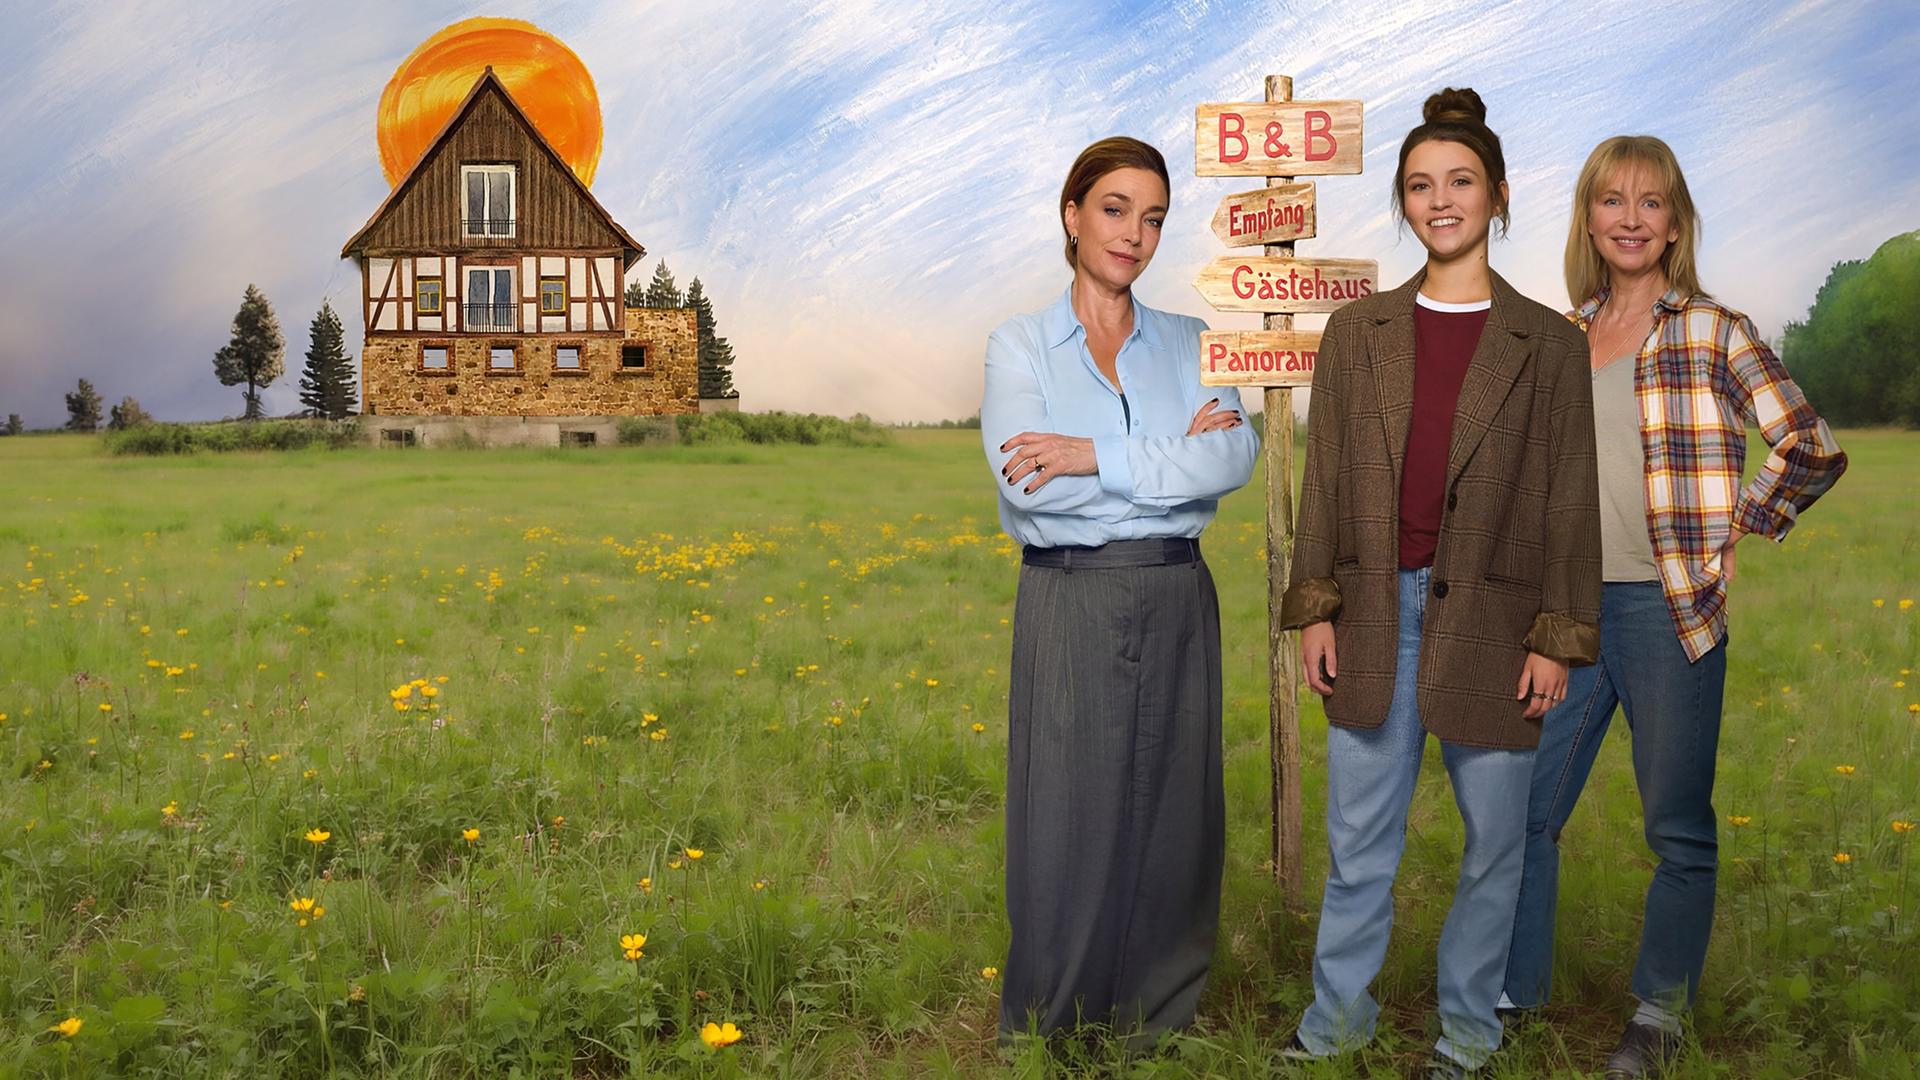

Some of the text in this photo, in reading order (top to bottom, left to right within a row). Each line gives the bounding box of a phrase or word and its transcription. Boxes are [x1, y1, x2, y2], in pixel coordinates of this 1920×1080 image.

[1218, 110, 1338, 163] B & B
[1229, 198, 1305, 239] Empfang
[1231, 264, 1372, 301] Gästehaus
